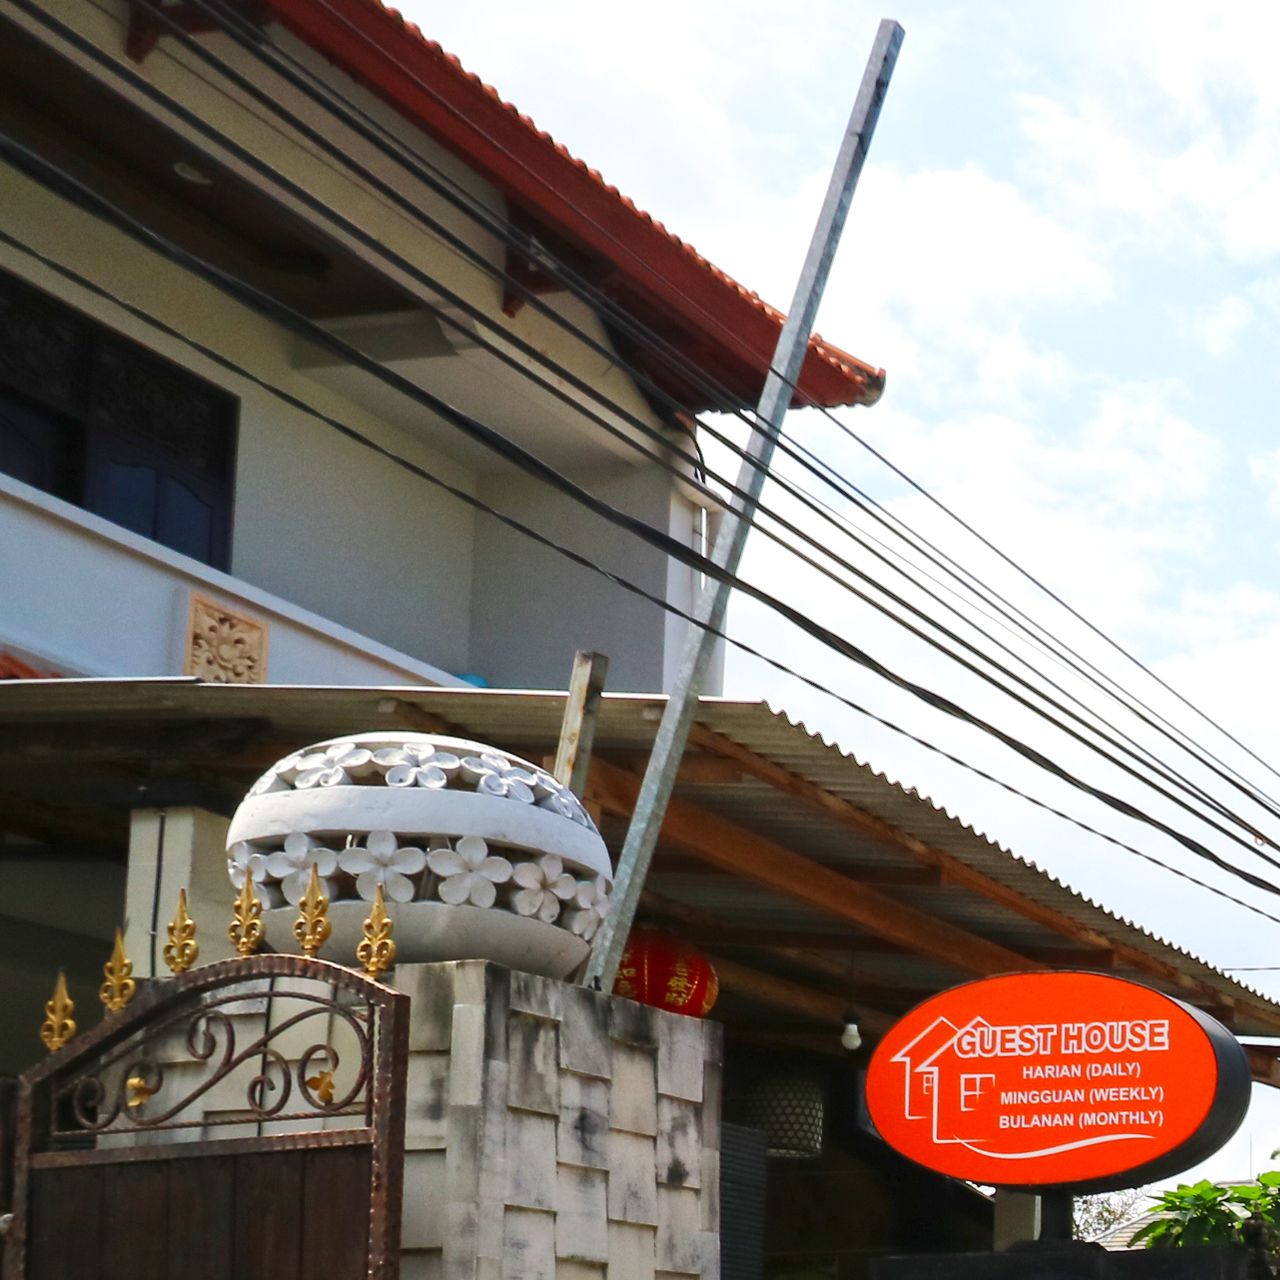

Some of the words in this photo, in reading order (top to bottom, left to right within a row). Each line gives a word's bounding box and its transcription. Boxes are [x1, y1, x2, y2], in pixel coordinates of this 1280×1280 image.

[953, 1023, 1057, 1059] GUEST
[1060, 1019, 1169, 1055] HOUSE
[1022, 1064, 1083, 1080] HARIAN
[1086, 1062, 1141, 1081] (DAILY)
[1000, 1087, 1085, 1105] MINGGUAN
[1089, 1085, 1164, 1105] (WEEKLY)
[999, 1112, 1075, 1130] BULANAN
[1078, 1109, 1164, 1129] (MONTHLY)
